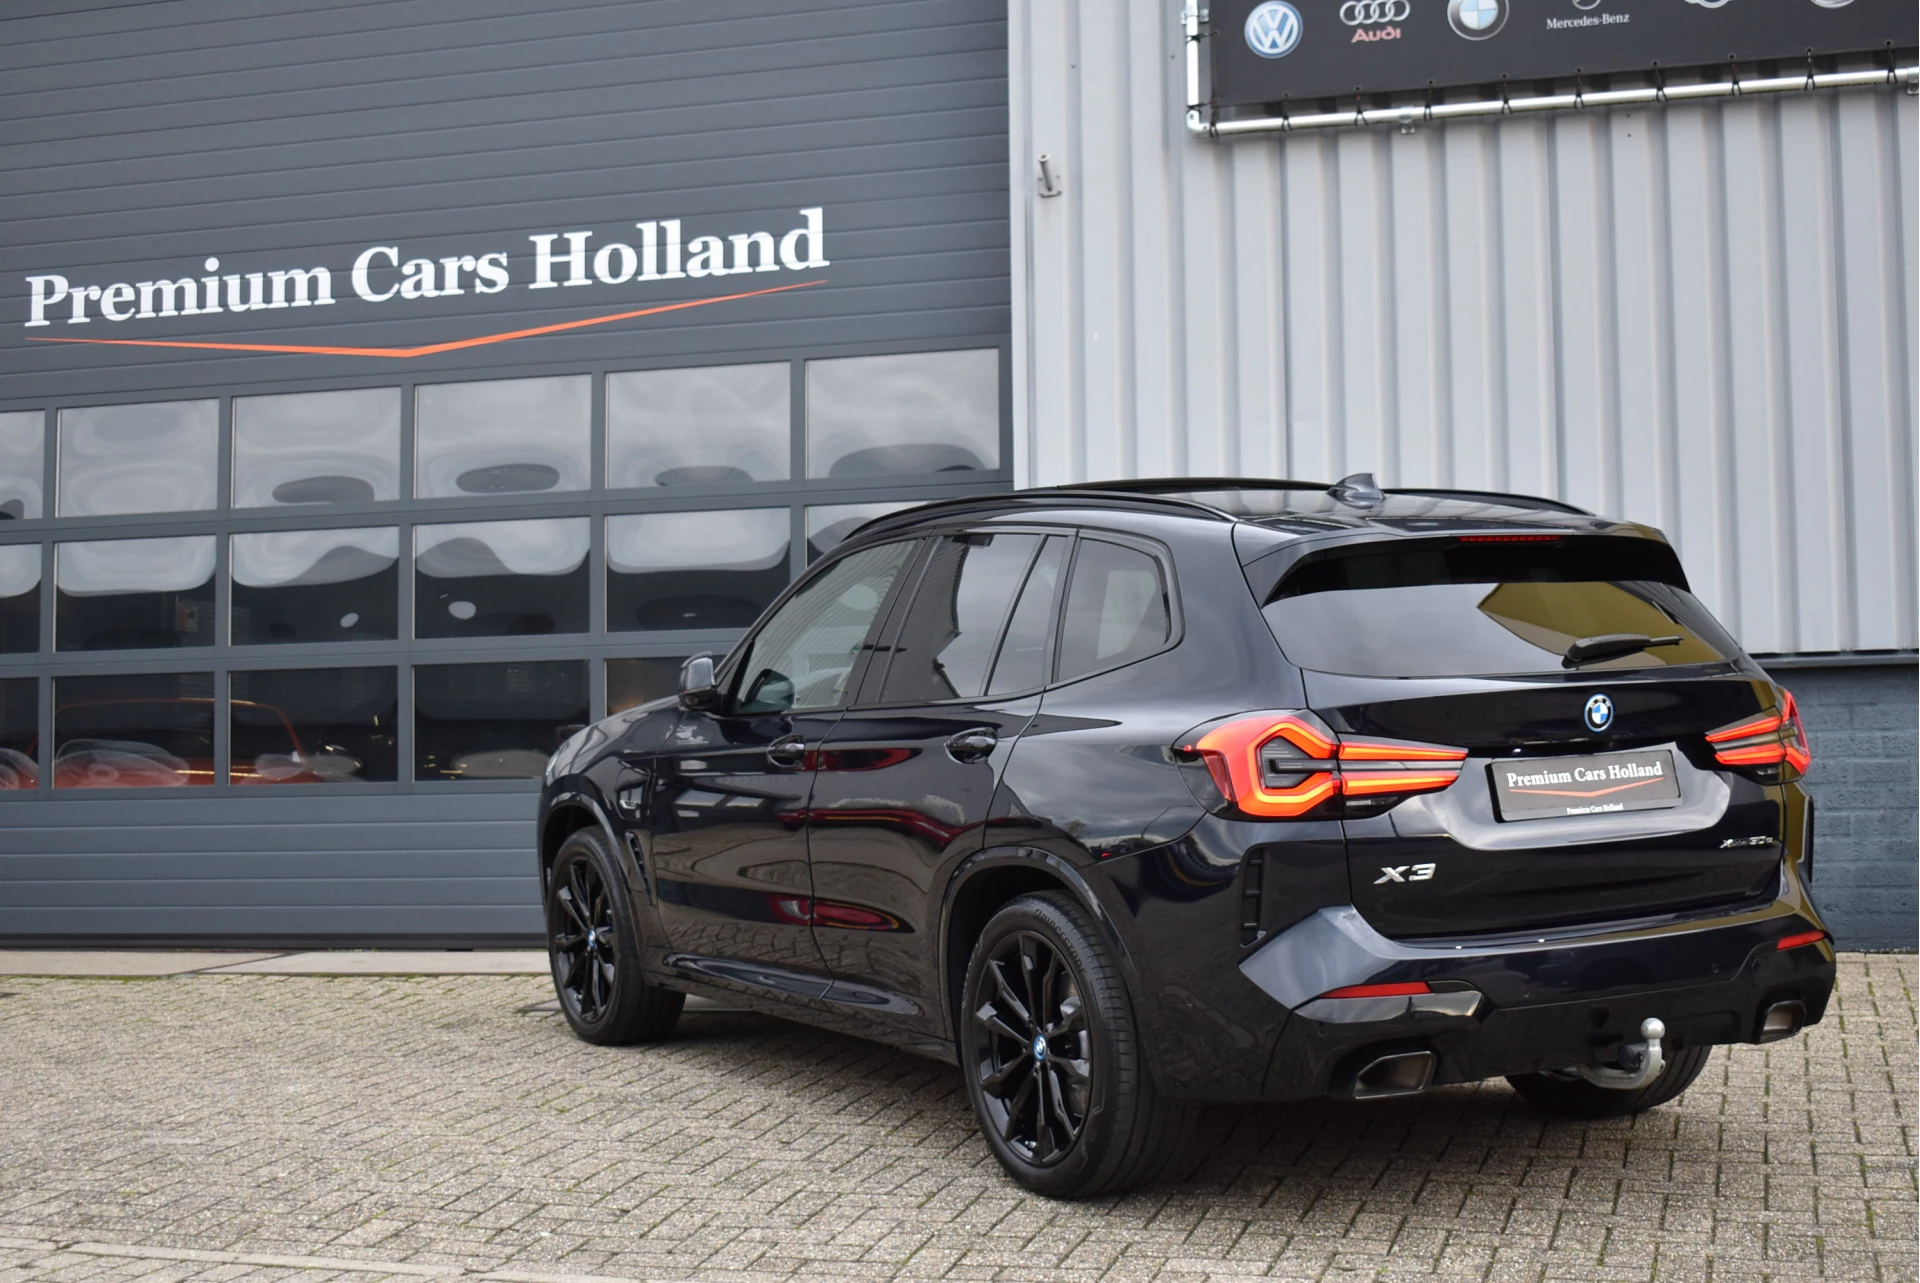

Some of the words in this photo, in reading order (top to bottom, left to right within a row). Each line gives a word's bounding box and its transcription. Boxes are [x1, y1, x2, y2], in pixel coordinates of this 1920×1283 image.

[1546, 13, 1630, 30] Mercedes-Benz
[1351, 26, 1402, 43] Audi
[24, 257, 336, 327] Premium
[351, 246, 510, 303] Cars
[528, 206, 831, 290] Holland
[1506, 770, 1573, 787] Premium
[1574, 767, 1607, 782] Cars
[1608, 761, 1664, 779] Holland
[1373, 862, 1437, 885] X3
